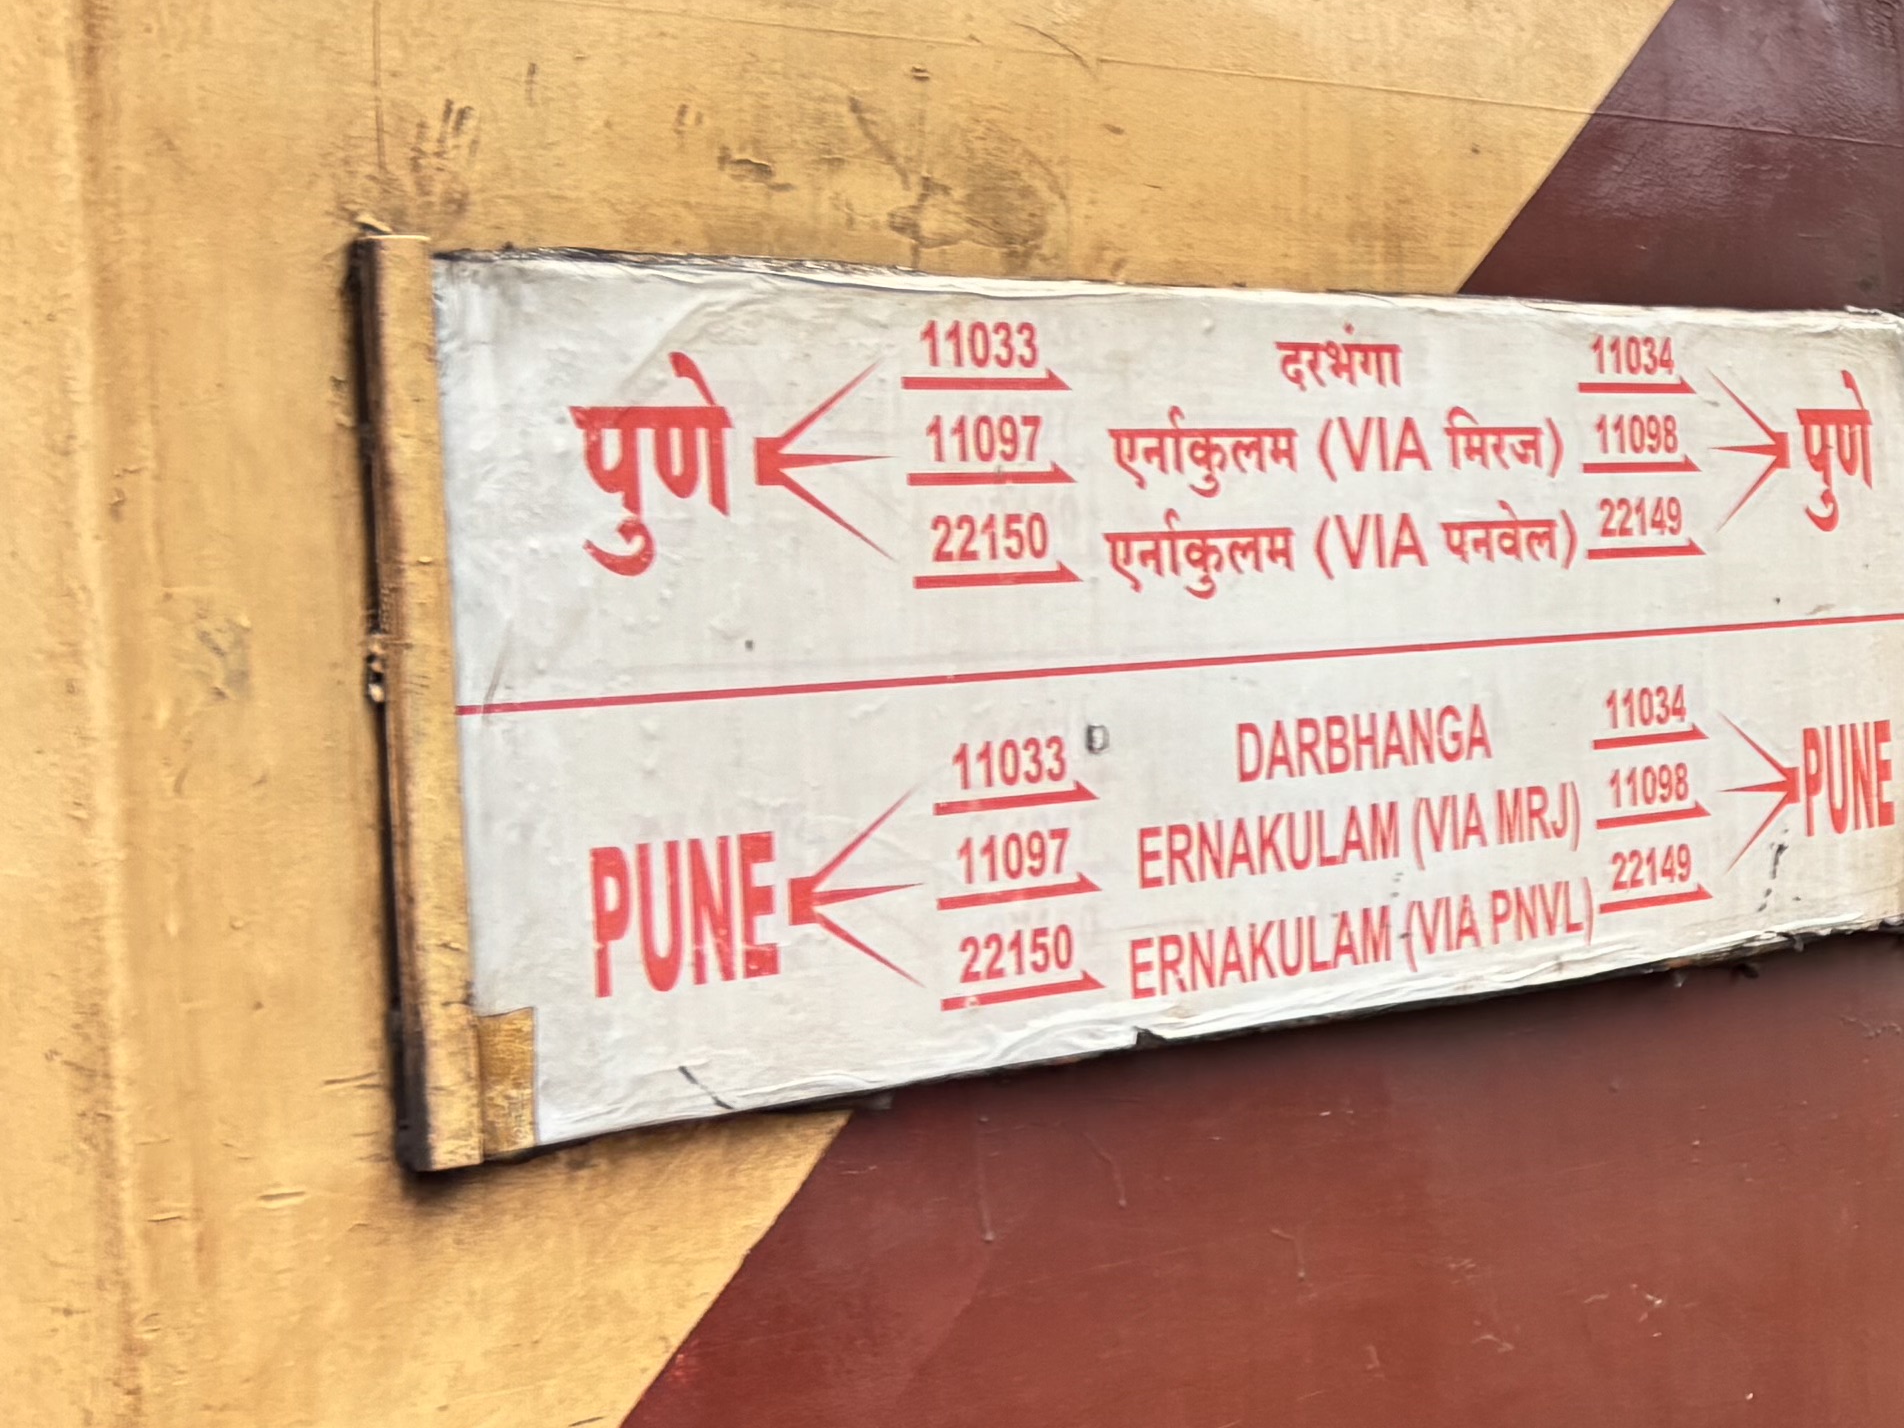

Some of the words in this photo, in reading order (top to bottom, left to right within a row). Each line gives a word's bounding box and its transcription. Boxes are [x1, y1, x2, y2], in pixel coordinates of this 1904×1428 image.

[921, 320, 1039, 369] 11033
[1276, 324, 1402, 391] दरभंगा
[1591, 335, 1676, 376] 11034
[926, 414, 1044, 464] 11097
[1108, 406, 1298, 498] एर्नाकुलम
[1317, 417, 1433, 482] (VIA
[1445, 407, 1565, 477] मिरज)
[1595, 414, 1680, 455] 11098
[1796, 370, 1873, 533] पुणे
[569, 352, 735, 577] पुणे
[932, 512, 1050, 563] 22150
[1599, 497, 1684, 538] 22149
[1104, 509, 1296, 600] एर्नाकुलम
[1313, 513, 1430, 580] (VIA
[1440, 501, 1579, 570] पनवेल)
[1605, 684, 1688, 728] 11034
[952, 735, 1068, 790] 11033
[1237, 704, 1493, 784] DARBHANGA
[1608, 762, 1690, 810] 11098
[1802, 719, 1897, 838] PUNE
[957, 828, 1071, 885] 11097
[1138, 801, 1400, 889] ERNAKULAM
[1412, 793, 1488, 871] (VIA
[1496, 780, 1582, 852] MRJ)
[1610, 842, 1693, 892] 22149
[589, 831, 781, 999] PUNE
[1129, 904, 1393, 999] ERNAKULAM
[1404, 893, 1482, 973] (VIA
[1490, 876, 1595, 947] PNVL)
[959, 924, 1074, 984] 22150
